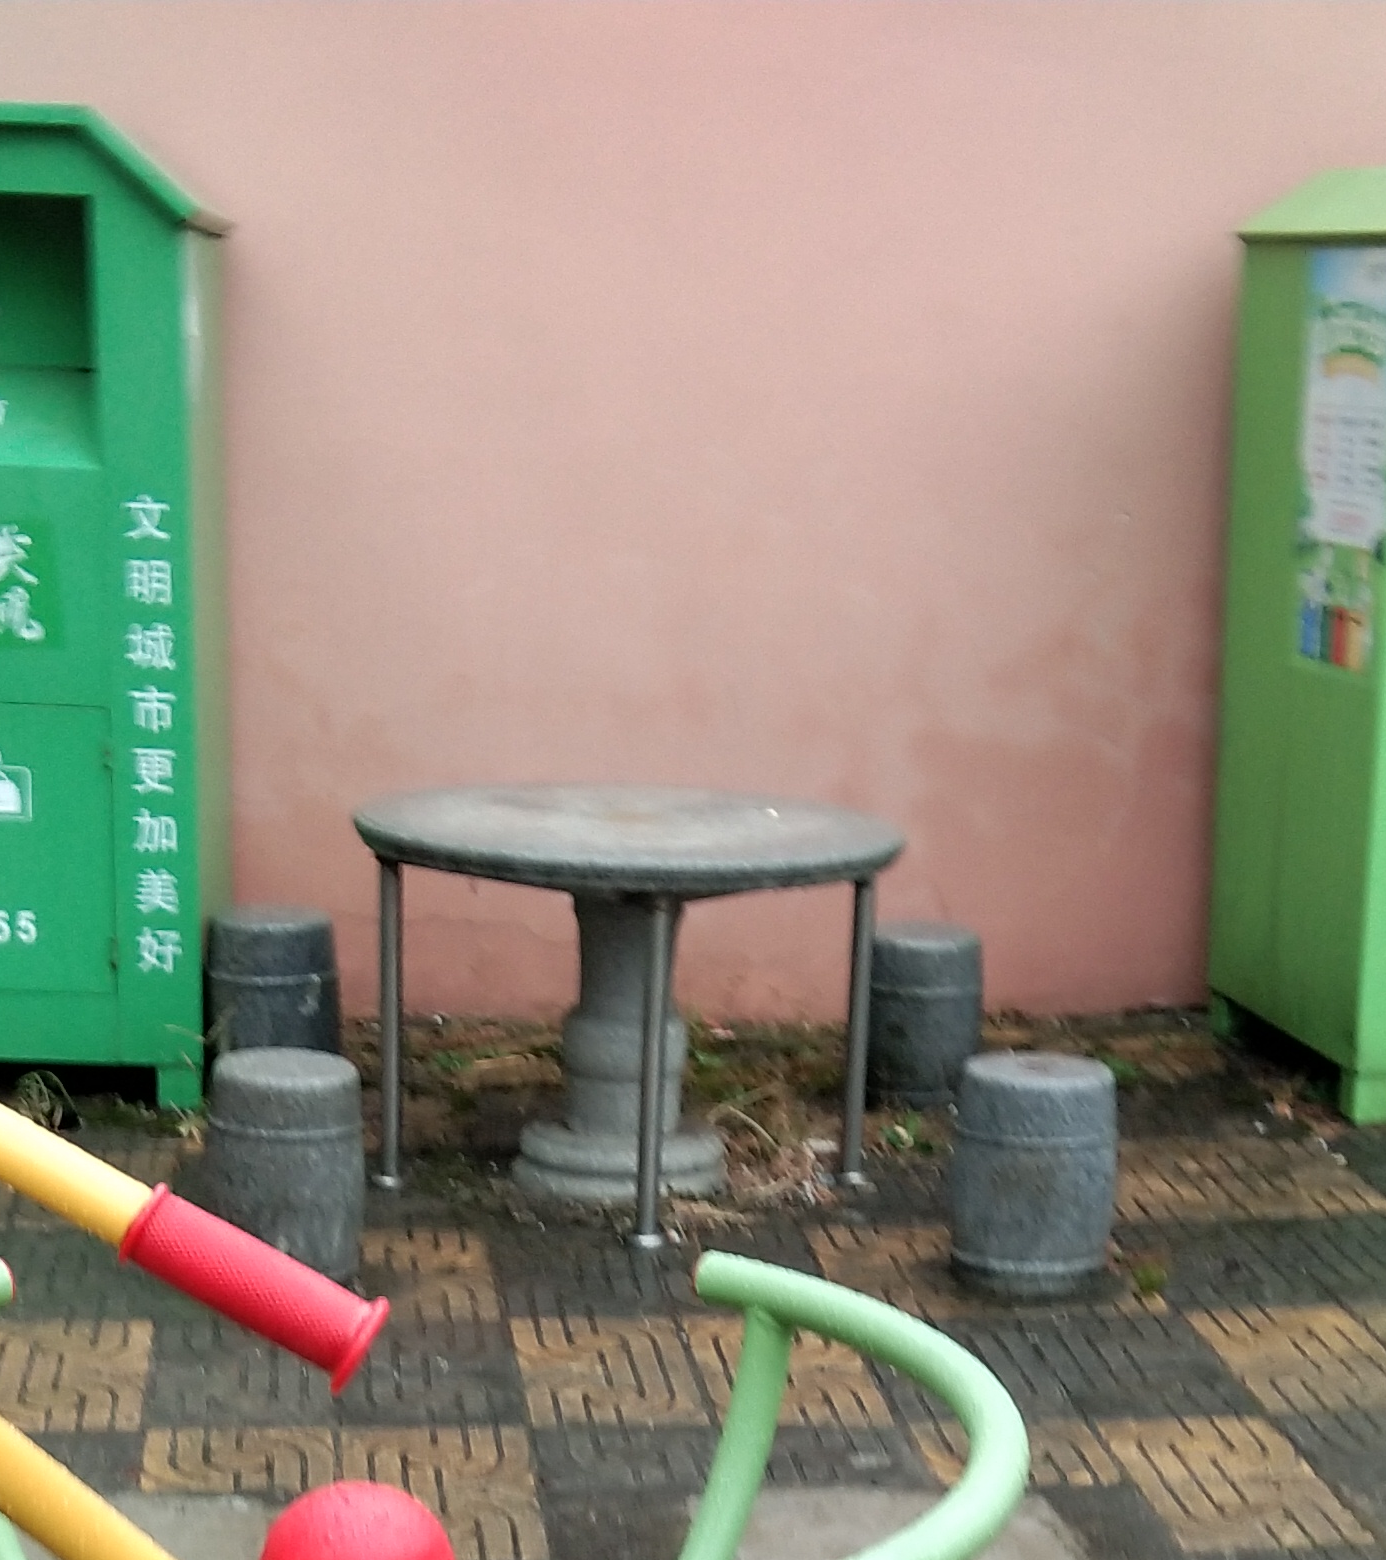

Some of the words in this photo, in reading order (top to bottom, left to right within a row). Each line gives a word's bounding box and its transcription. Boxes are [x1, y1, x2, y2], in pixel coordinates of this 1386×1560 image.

[122, 494, 184, 974] 文明城市更加美好
